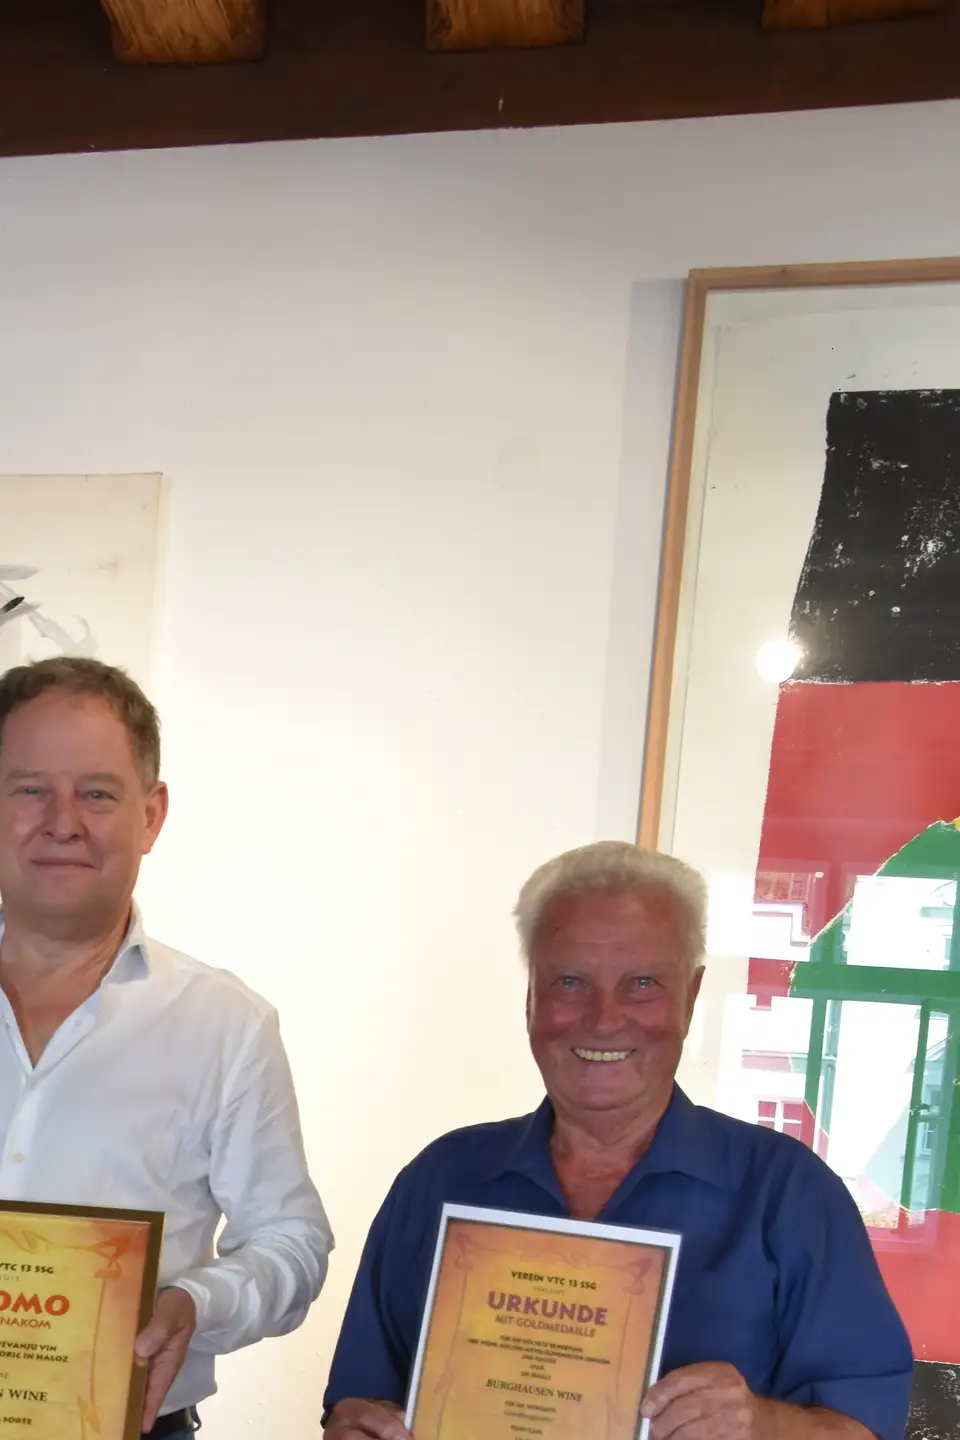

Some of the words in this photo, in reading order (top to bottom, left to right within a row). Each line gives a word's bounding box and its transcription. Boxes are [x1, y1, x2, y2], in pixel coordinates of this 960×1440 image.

[21, 1264, 32, 1273] 13
[34, 1265, 55, 1275] SSG
[510, 1270, 544, 1283] VEREIN
[547, 1276, 565, 1286] VTC
[568, 1279, 578, 1288] 13
[580, 1280, 597, 1290] SSG
[487, 1290, 608, 1326] URKUNDE
[495, 1314, 514, 1325] MIT
[516, 1318, 596, 1338] GOLDMEDAILLE
[39, 1344, 57, 1352] VIN
[9, 1388, 48, 1402] WINE
[486, 1379, 554, 1397] BURGHAUSEN
[557, 1389, 583, 1402] WINE
